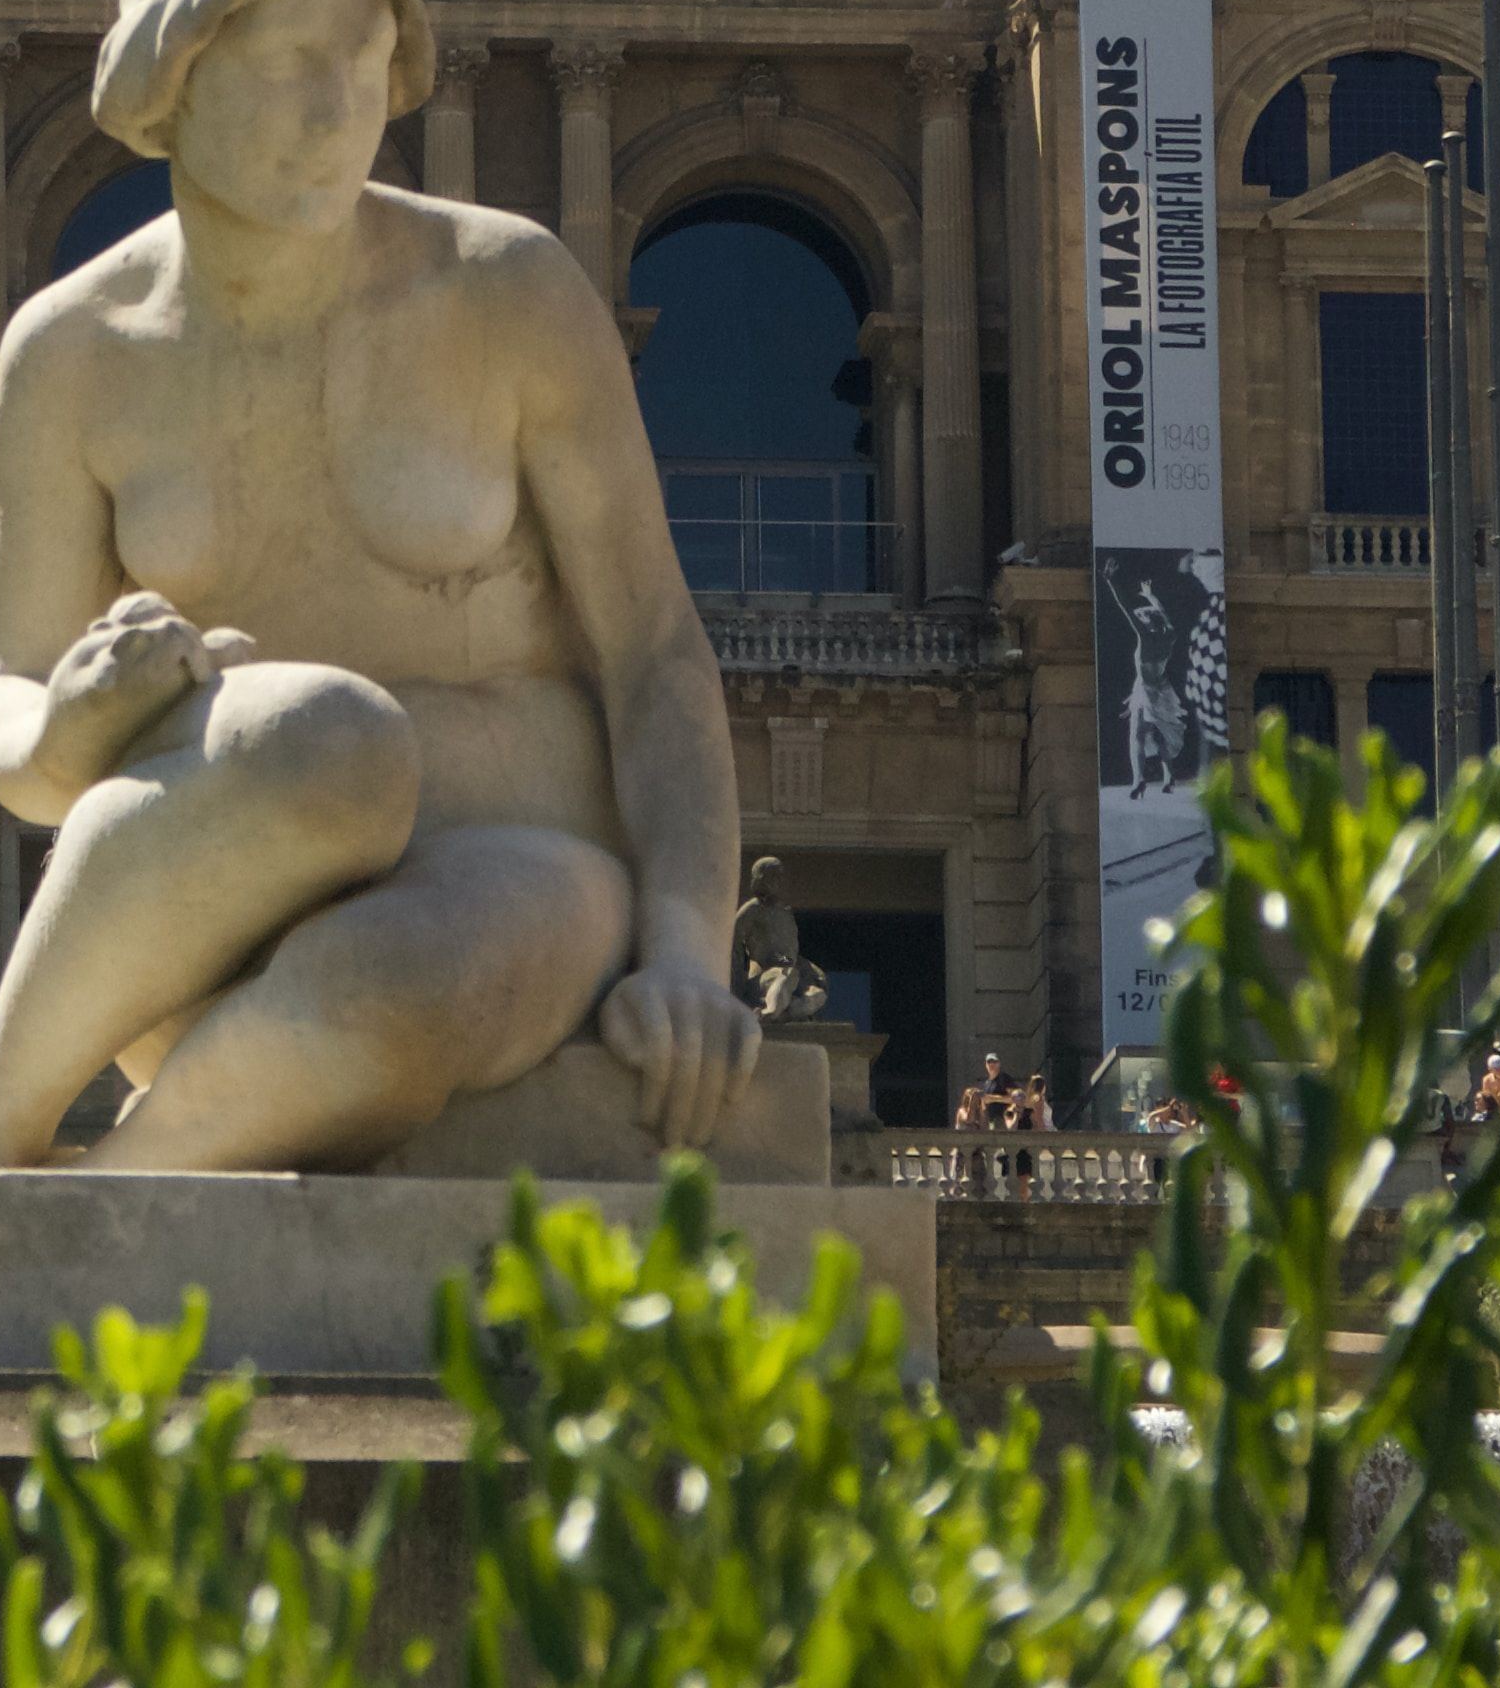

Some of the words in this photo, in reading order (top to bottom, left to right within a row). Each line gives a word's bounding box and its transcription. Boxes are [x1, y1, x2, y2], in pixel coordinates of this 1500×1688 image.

[1144, 113, 1203, 164] ÚTIL
[1095, 36, 1143, 308] MASPONS
[1155, 171, 1206, 314] FOTOGRAFIA
[1157, 322, 1207, 349] LA
[1100, 318, 1147, 489] ORIOL
[1162, 423, 1211, 452] 1949
[1162, 462, 1211, 491] 1995
